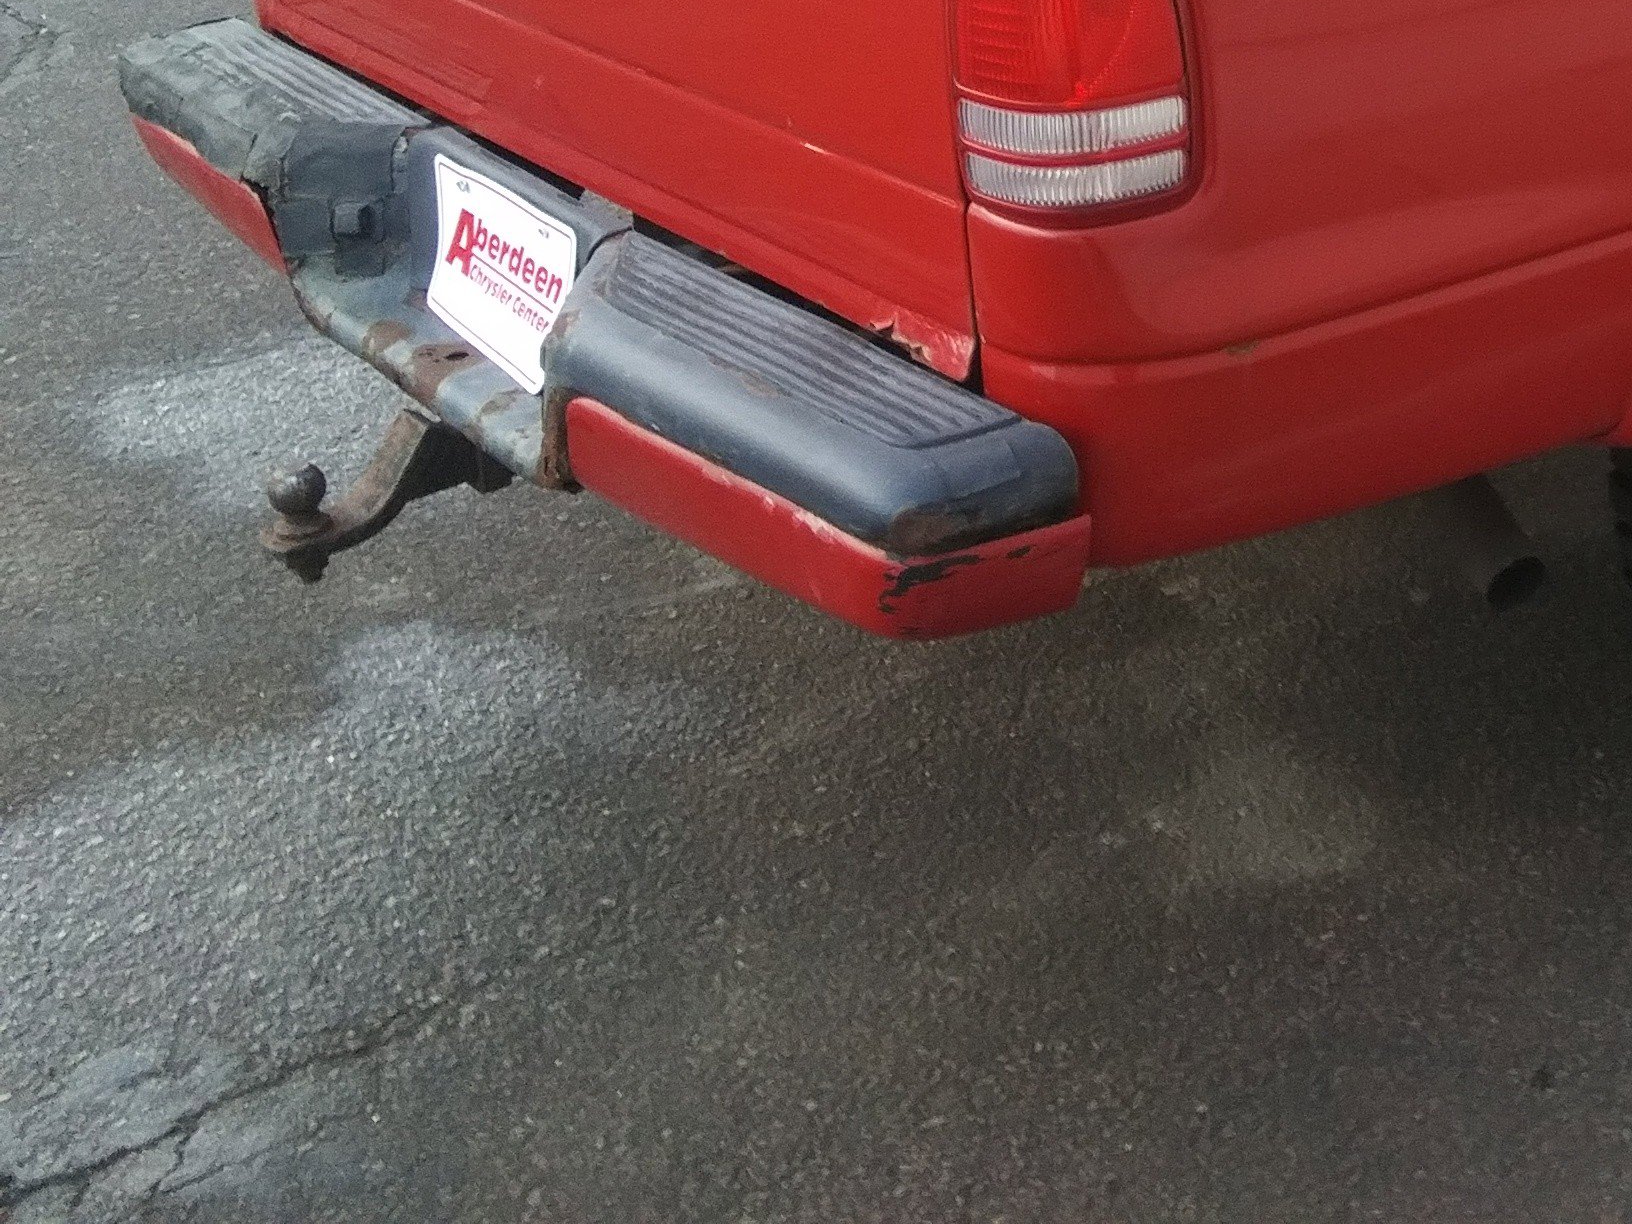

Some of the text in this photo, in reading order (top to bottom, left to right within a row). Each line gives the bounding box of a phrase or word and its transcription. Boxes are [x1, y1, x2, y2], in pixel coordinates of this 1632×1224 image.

[445, 208, 563, 304] Aberdeen
[470, 263, 550, 334] Chrysler Center
